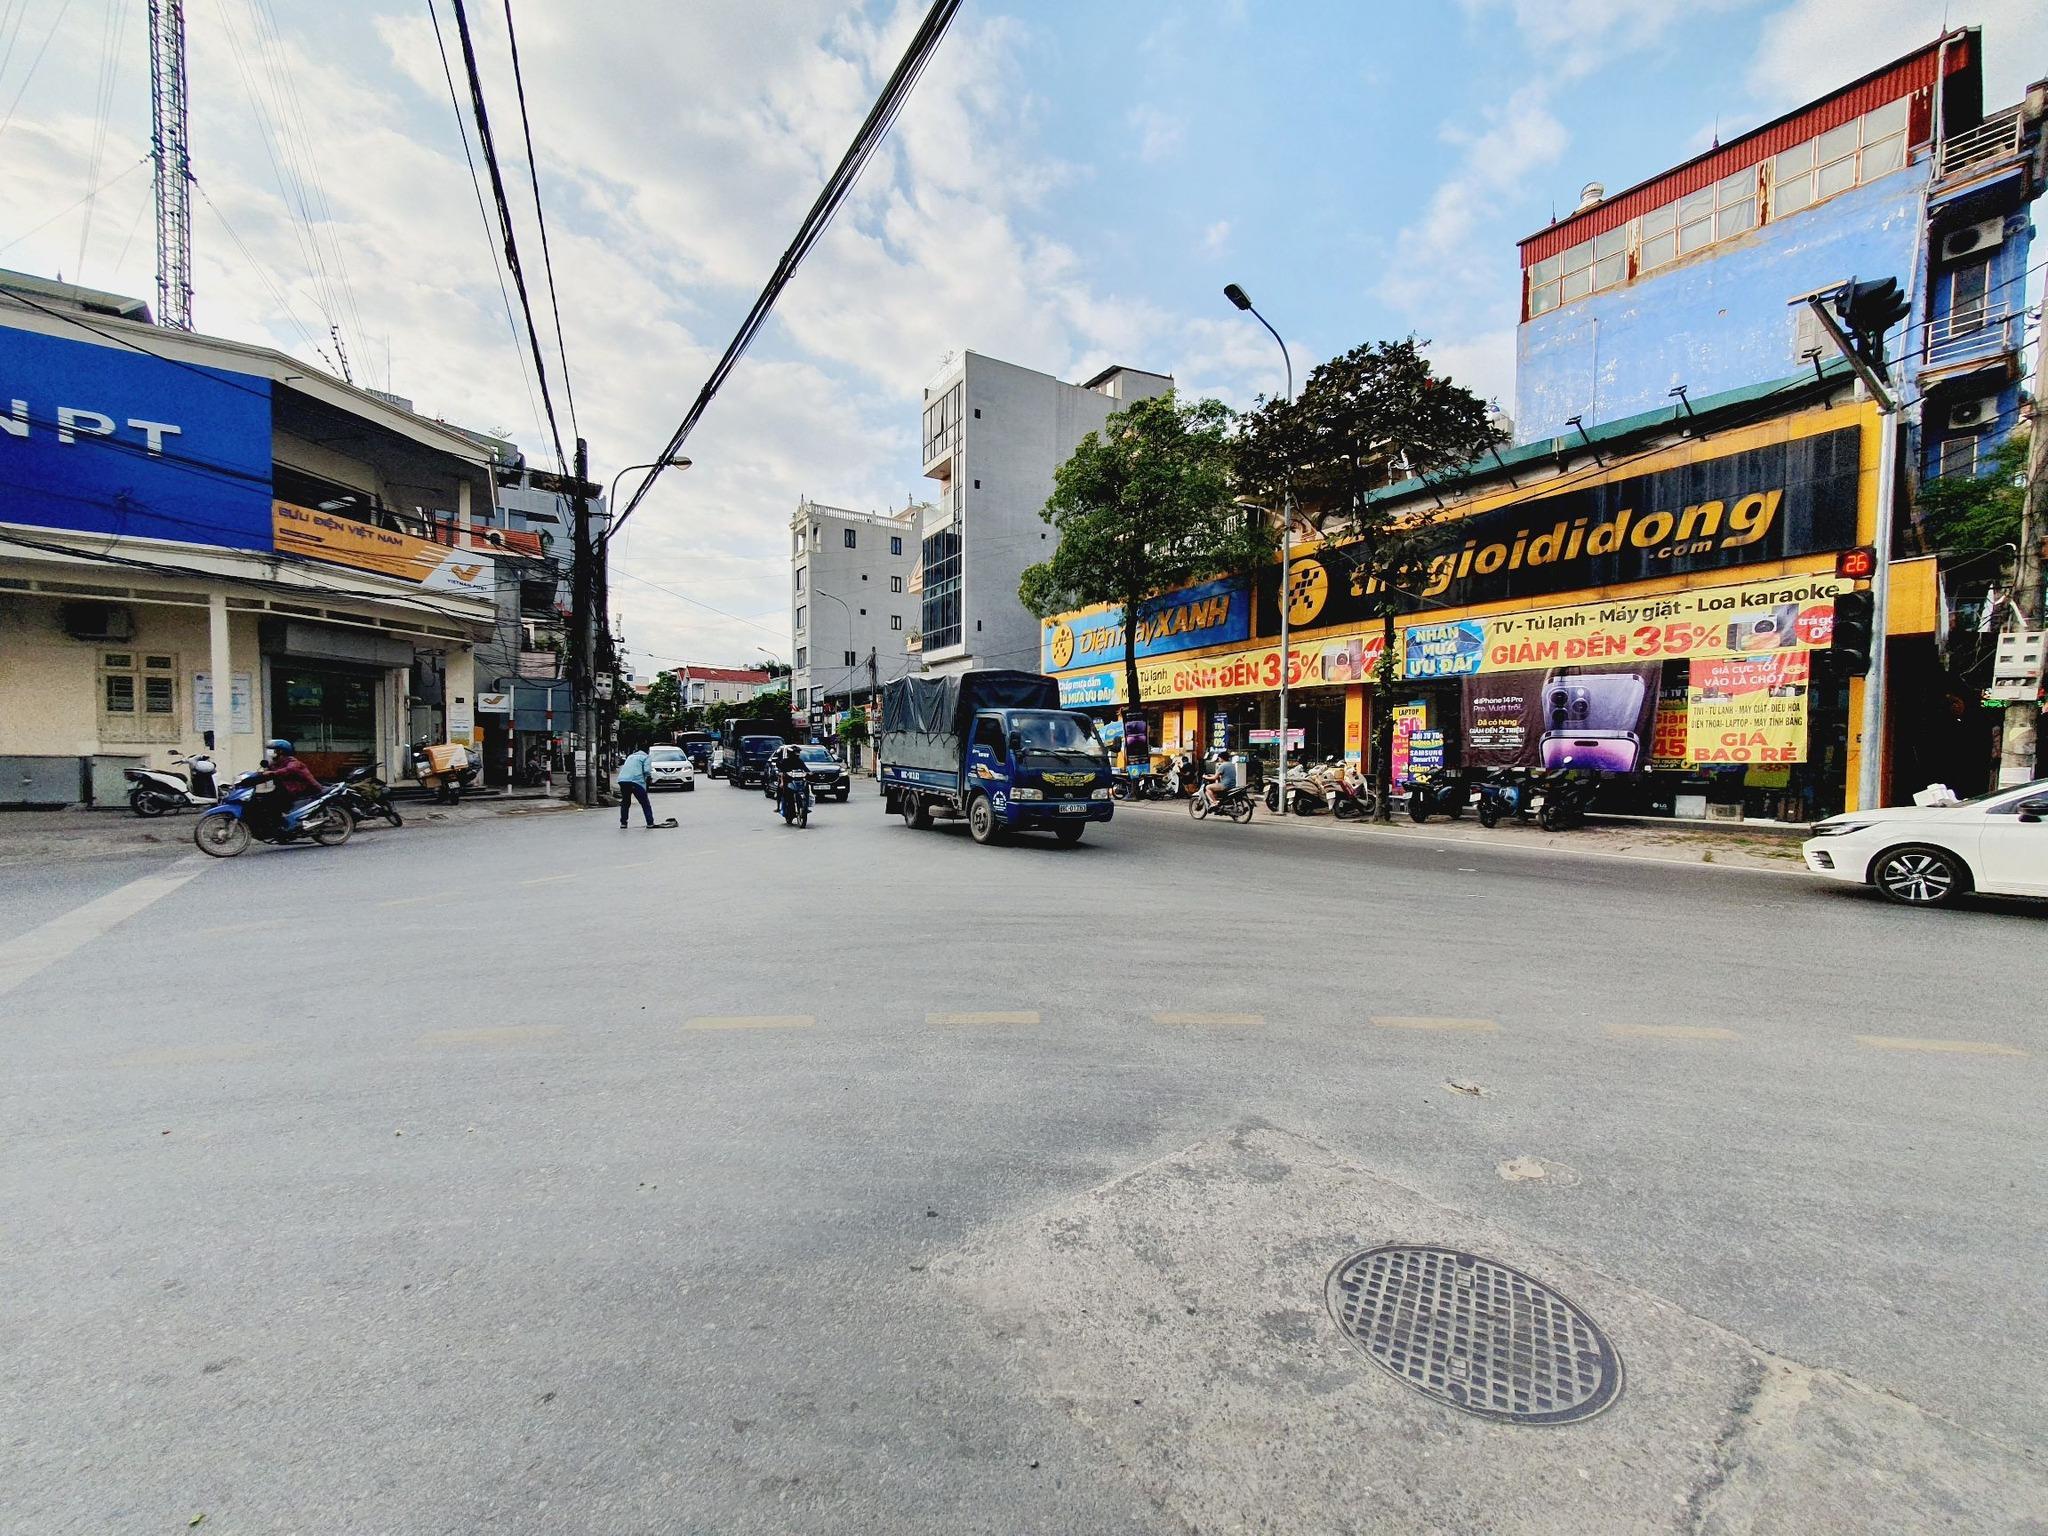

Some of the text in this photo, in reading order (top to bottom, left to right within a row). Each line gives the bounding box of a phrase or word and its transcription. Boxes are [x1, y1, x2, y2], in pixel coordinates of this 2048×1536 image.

[279, 507, 402, 546] BƯU ĐIỆN VIỆT NAM
[1349, 489, 1784, 597] thgioididong
[1649, 540, 1712, 560] .com
[1845, 552, 1868, 572] 26
[1493, 583, 1840, 635] TV Tủ lạnh Máy giặt Loa karaoke
[1080, 624, 1116, 655] Điện
[1491, 622, 1722, 665] GIẢM ĐẾN 35%
[1150, 668, 1168, 683] lạnh
[1174, 650, 1320, 692] GIẢM ĐẾN 35%
[1711, 659, 1778, 675] GIÁ CỰC TỐT
[1704, 671, 1785, 687] VÀO LÀ CHỐT
[1157, 684, 1171, 695] Loa
[1399, 708, 1420, 716] LAPTOP
[1498, 726, 1505, 734] 2
[1720, 728, 1769, 747] GIÁ
[1410, 749, 1443, 757] SAMSUNG
[1694, 741, 1798, 761] BAO RẺ
